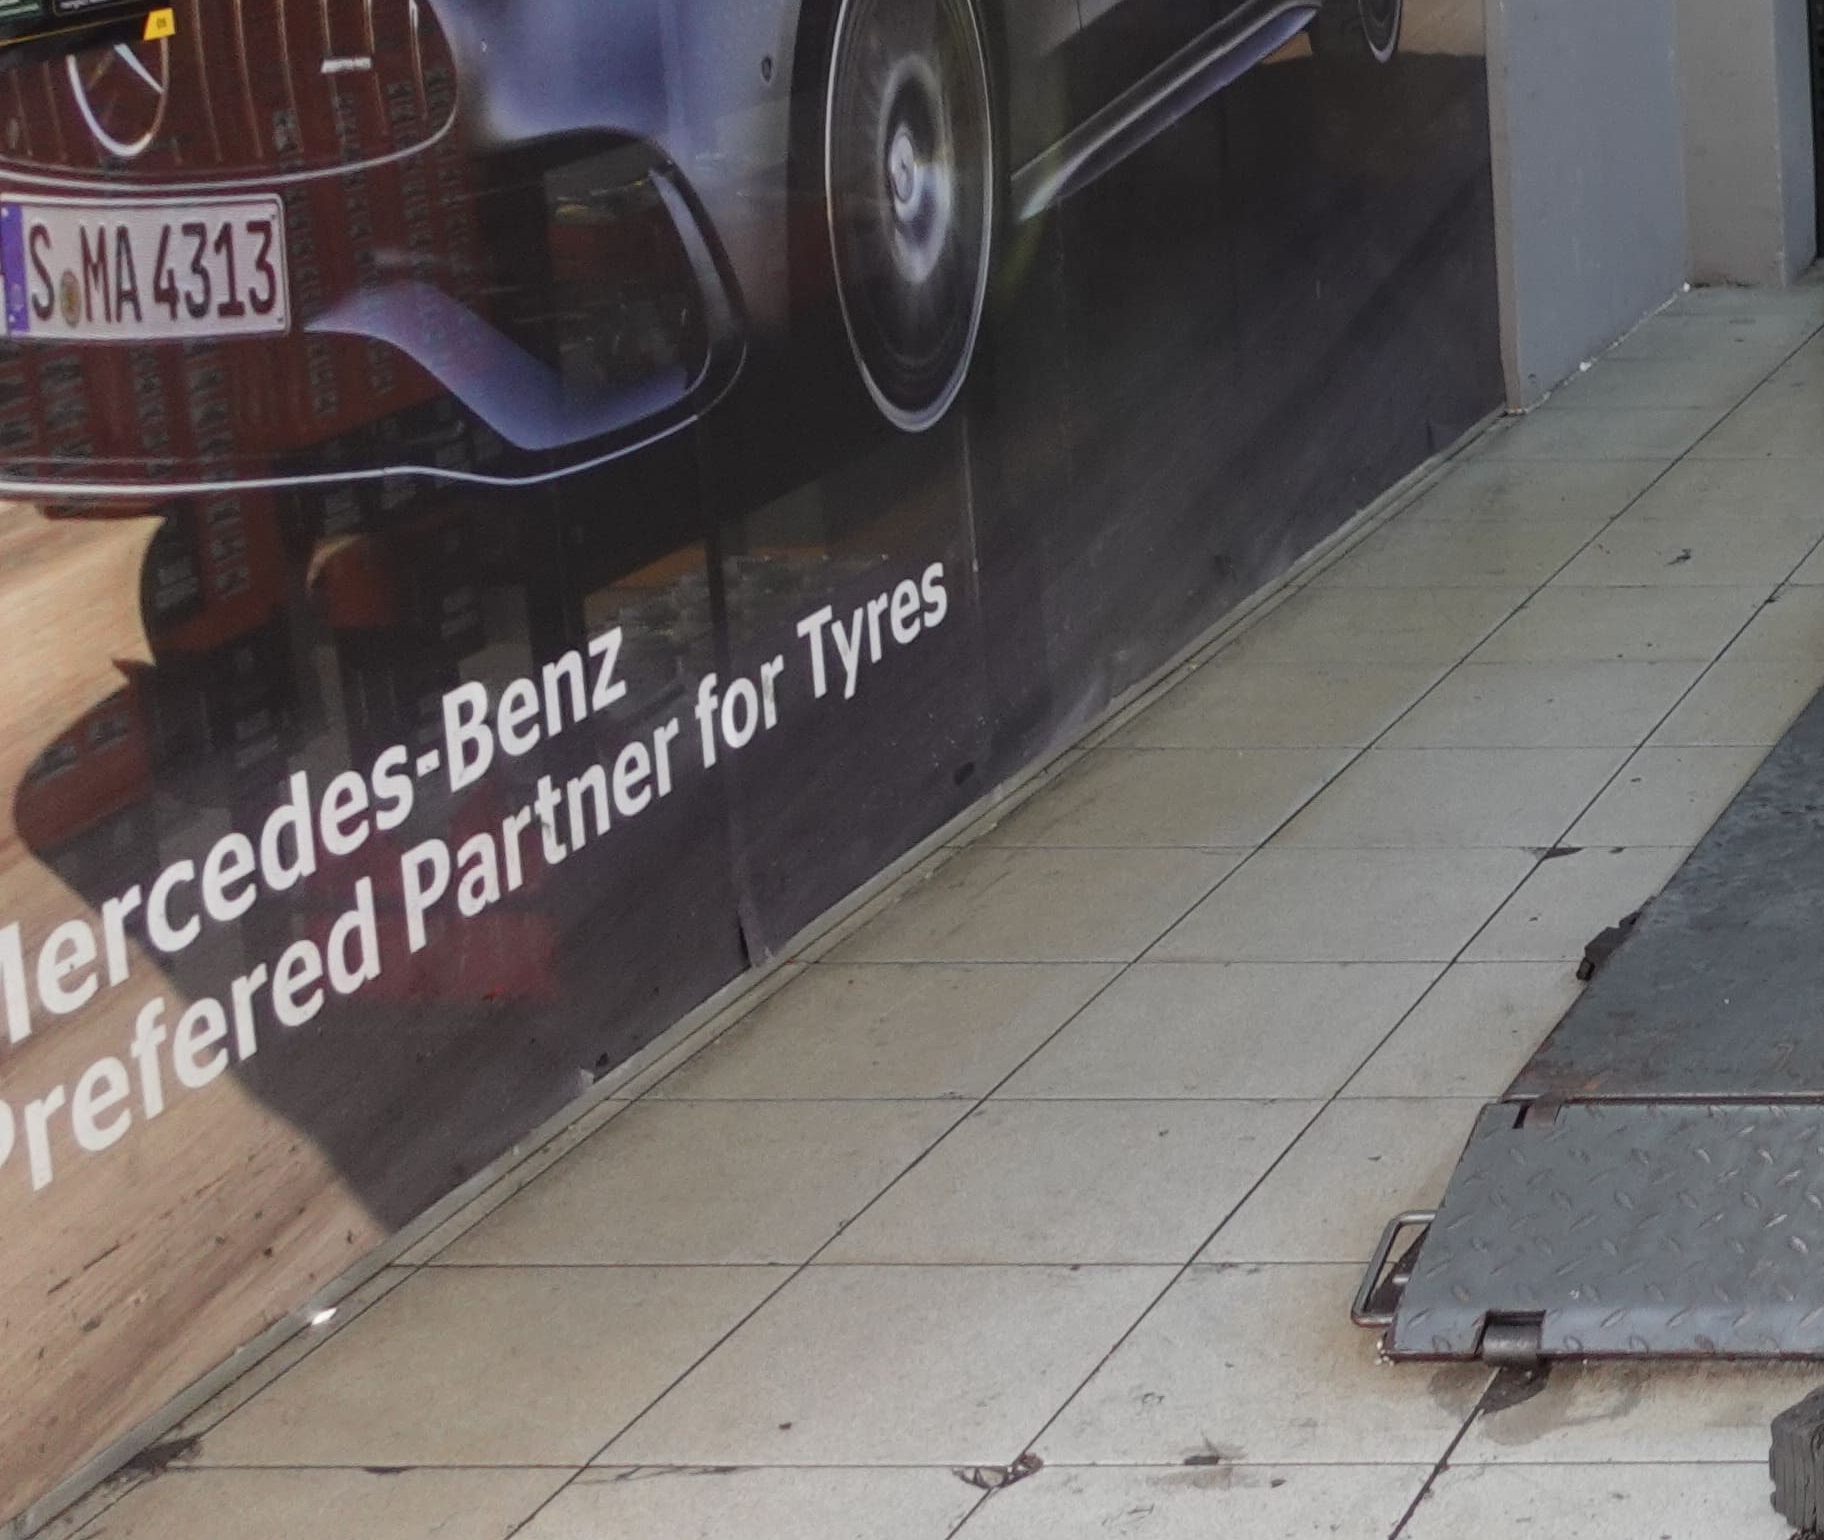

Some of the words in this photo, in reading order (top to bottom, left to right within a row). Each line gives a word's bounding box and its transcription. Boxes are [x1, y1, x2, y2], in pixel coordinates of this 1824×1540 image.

[29, 222, 55, 321] S
[80, 224, 142, 324] MA
[152, 220, 278, 320] 4313
[400, 714, 680, 952] Partner
[694, 655, 785, 768] for
[797, 561, 949, 701] Tyres
